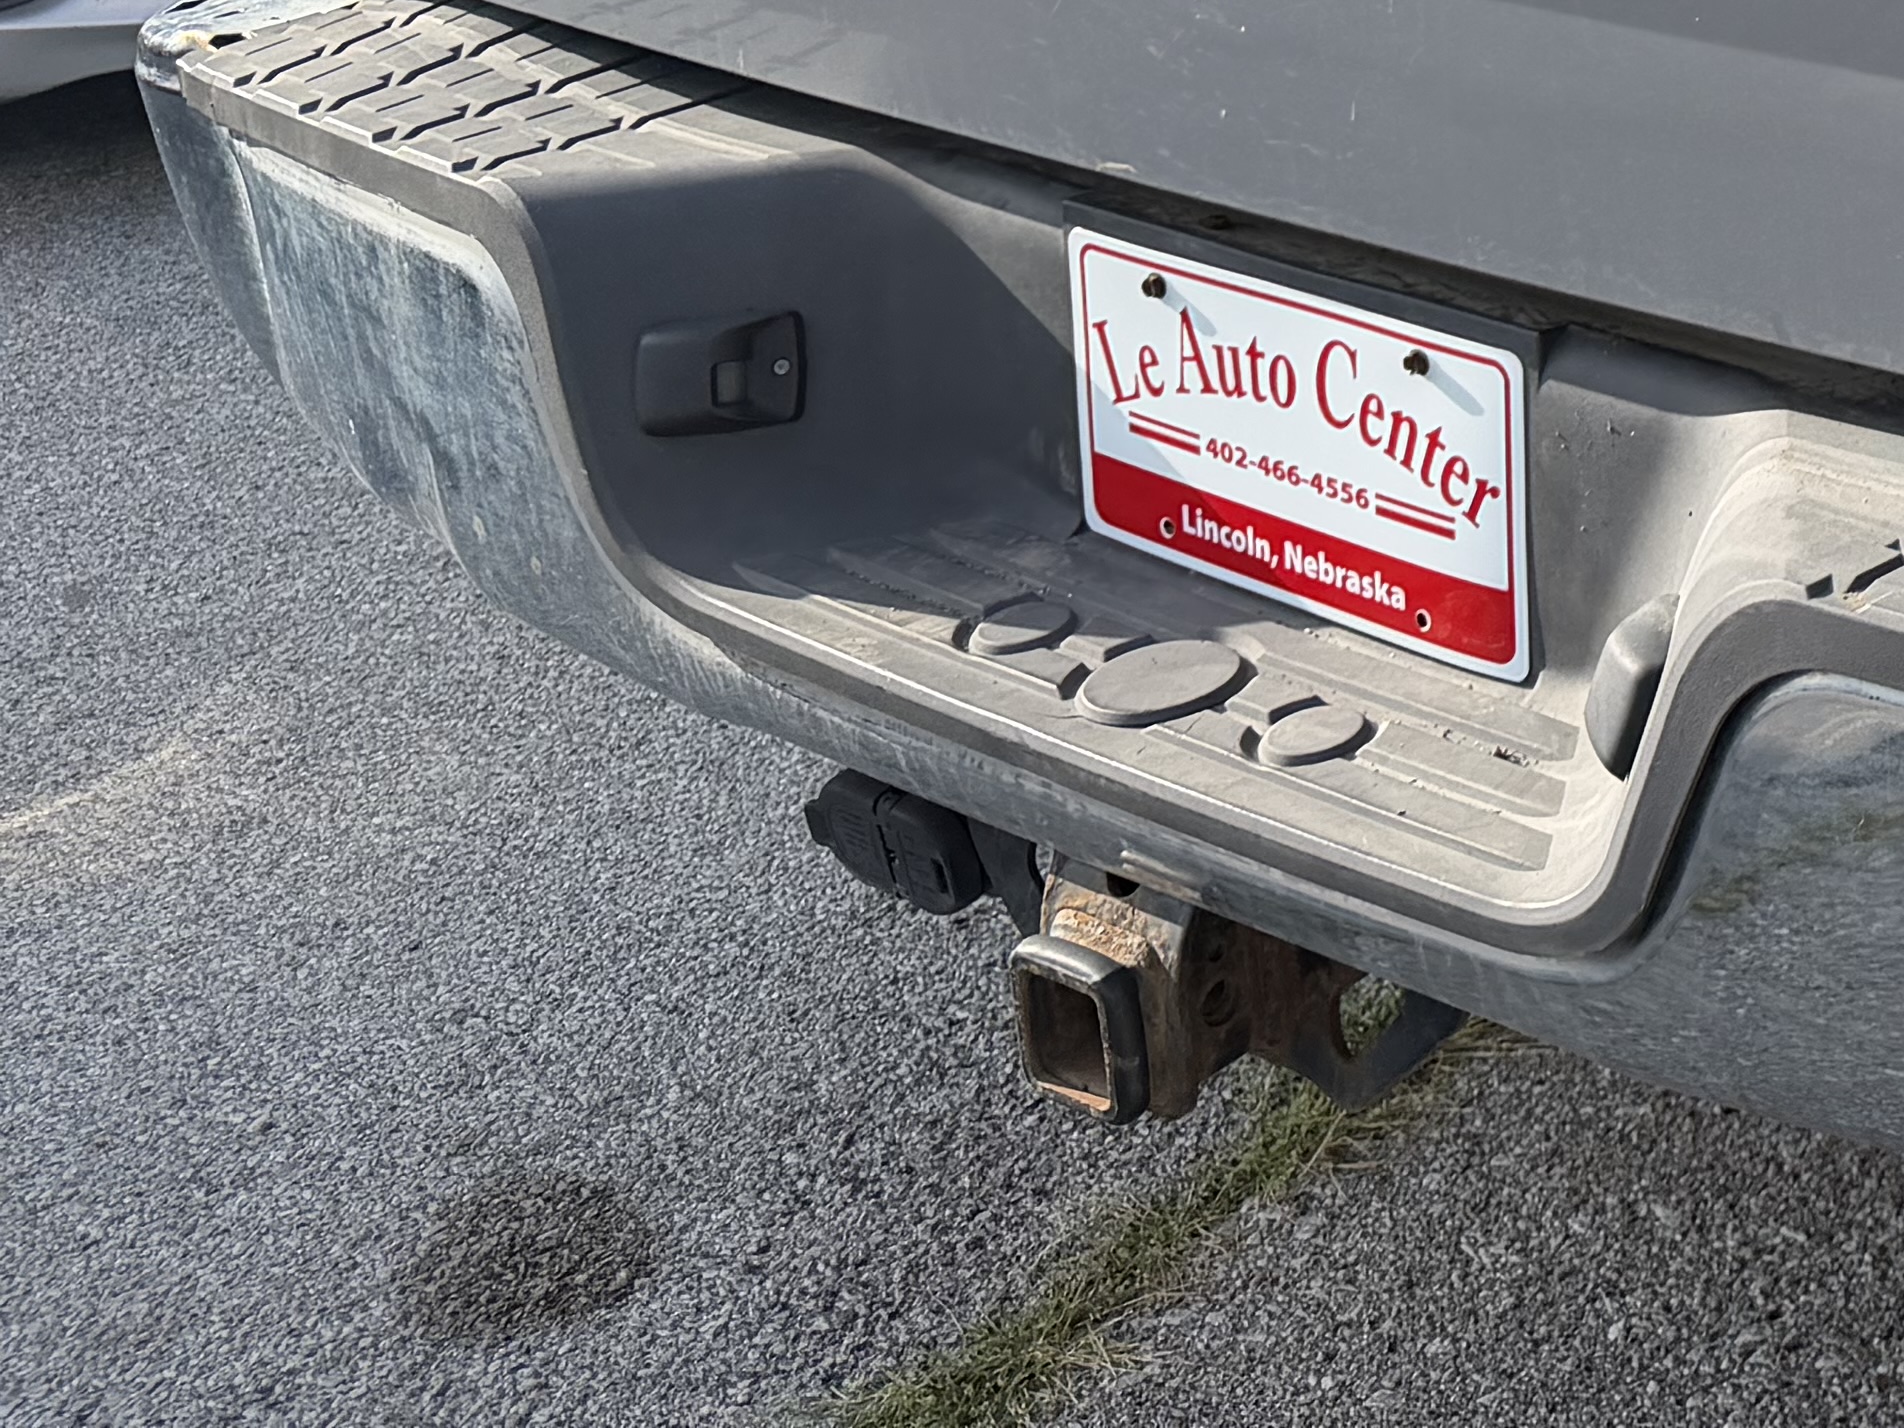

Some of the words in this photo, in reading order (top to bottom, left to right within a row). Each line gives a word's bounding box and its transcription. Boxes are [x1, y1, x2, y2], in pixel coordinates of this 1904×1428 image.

[1092, 319, 1166, 406] Le
[1175, 306, 1298, 410] Auto
[1315, 339, 1501, 529] Center
[1205, 437, 1370, 510] 402-466-4556
[1181, 504, 1280, 569] Lincoln,
[1283, 540, 1407, 612] Nebraska
